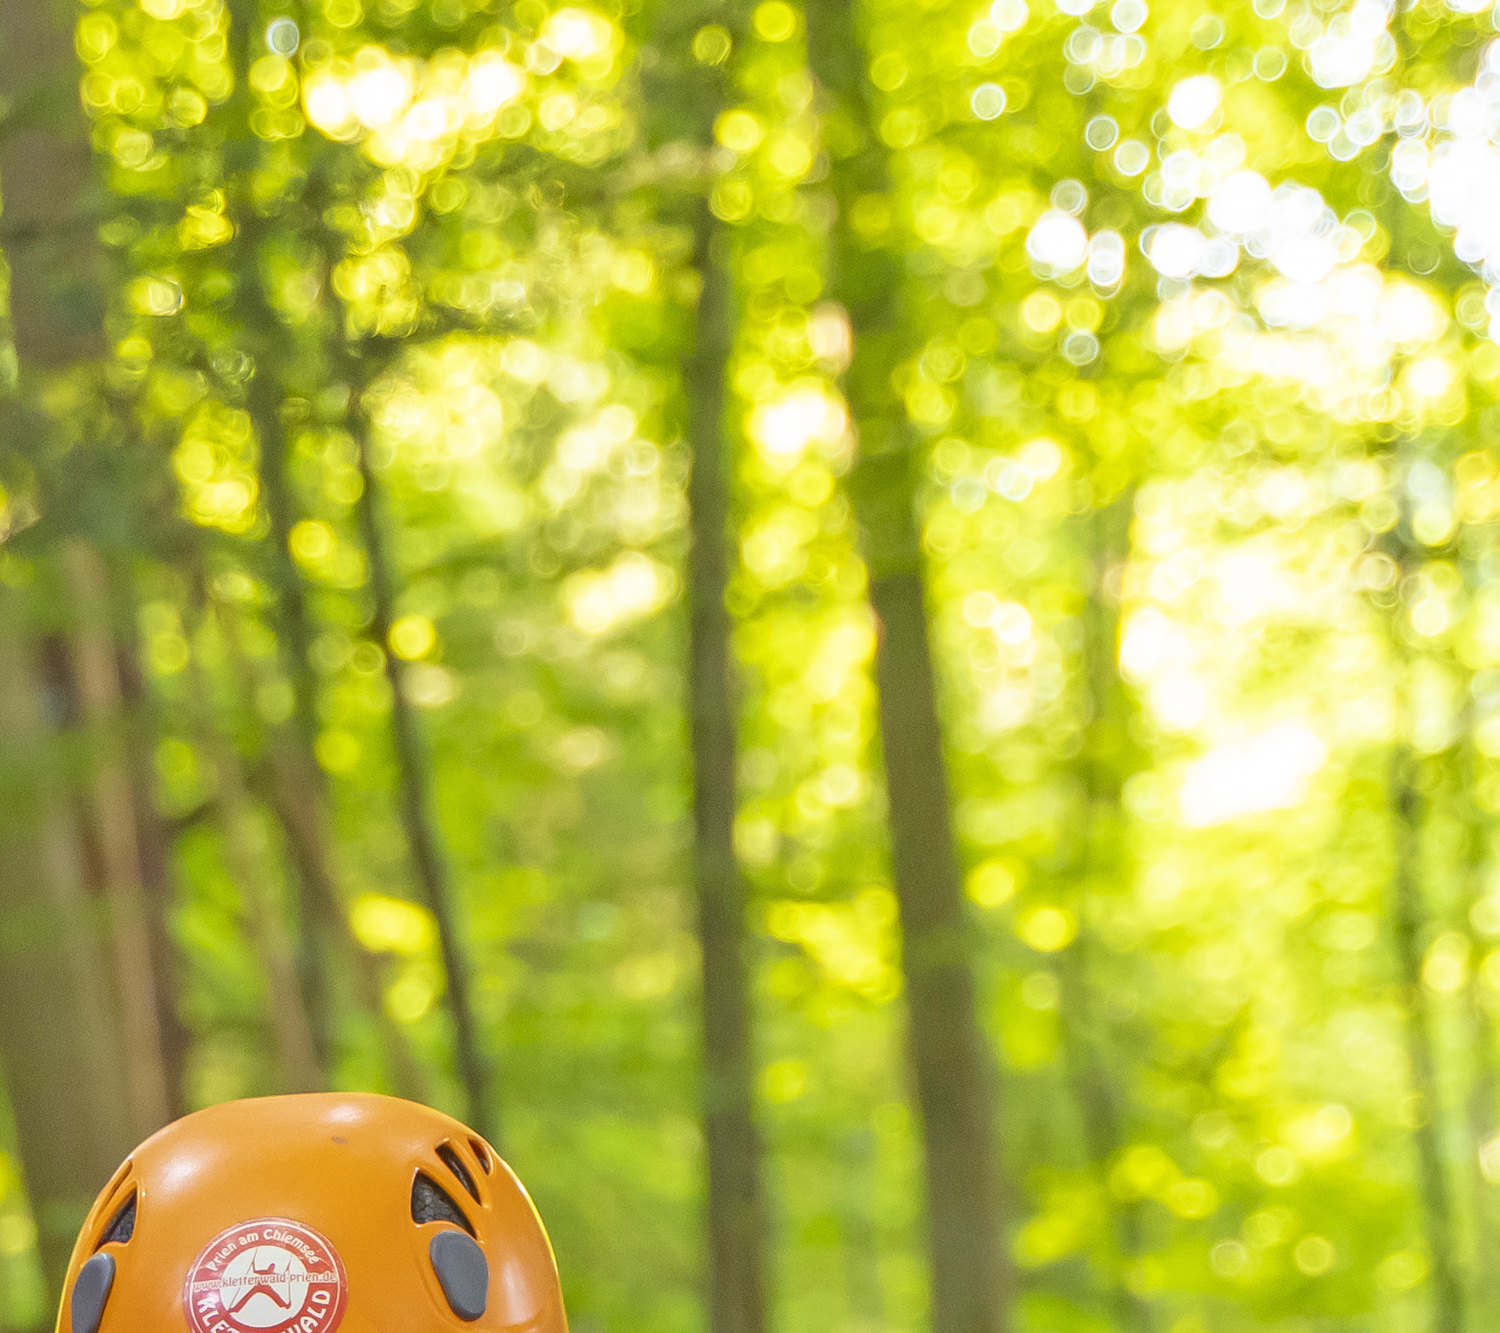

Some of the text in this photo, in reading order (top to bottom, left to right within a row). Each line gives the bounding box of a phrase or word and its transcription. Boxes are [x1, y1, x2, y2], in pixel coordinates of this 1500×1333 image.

[205, 1228, 320, 1271] Prien am Chiemsee
